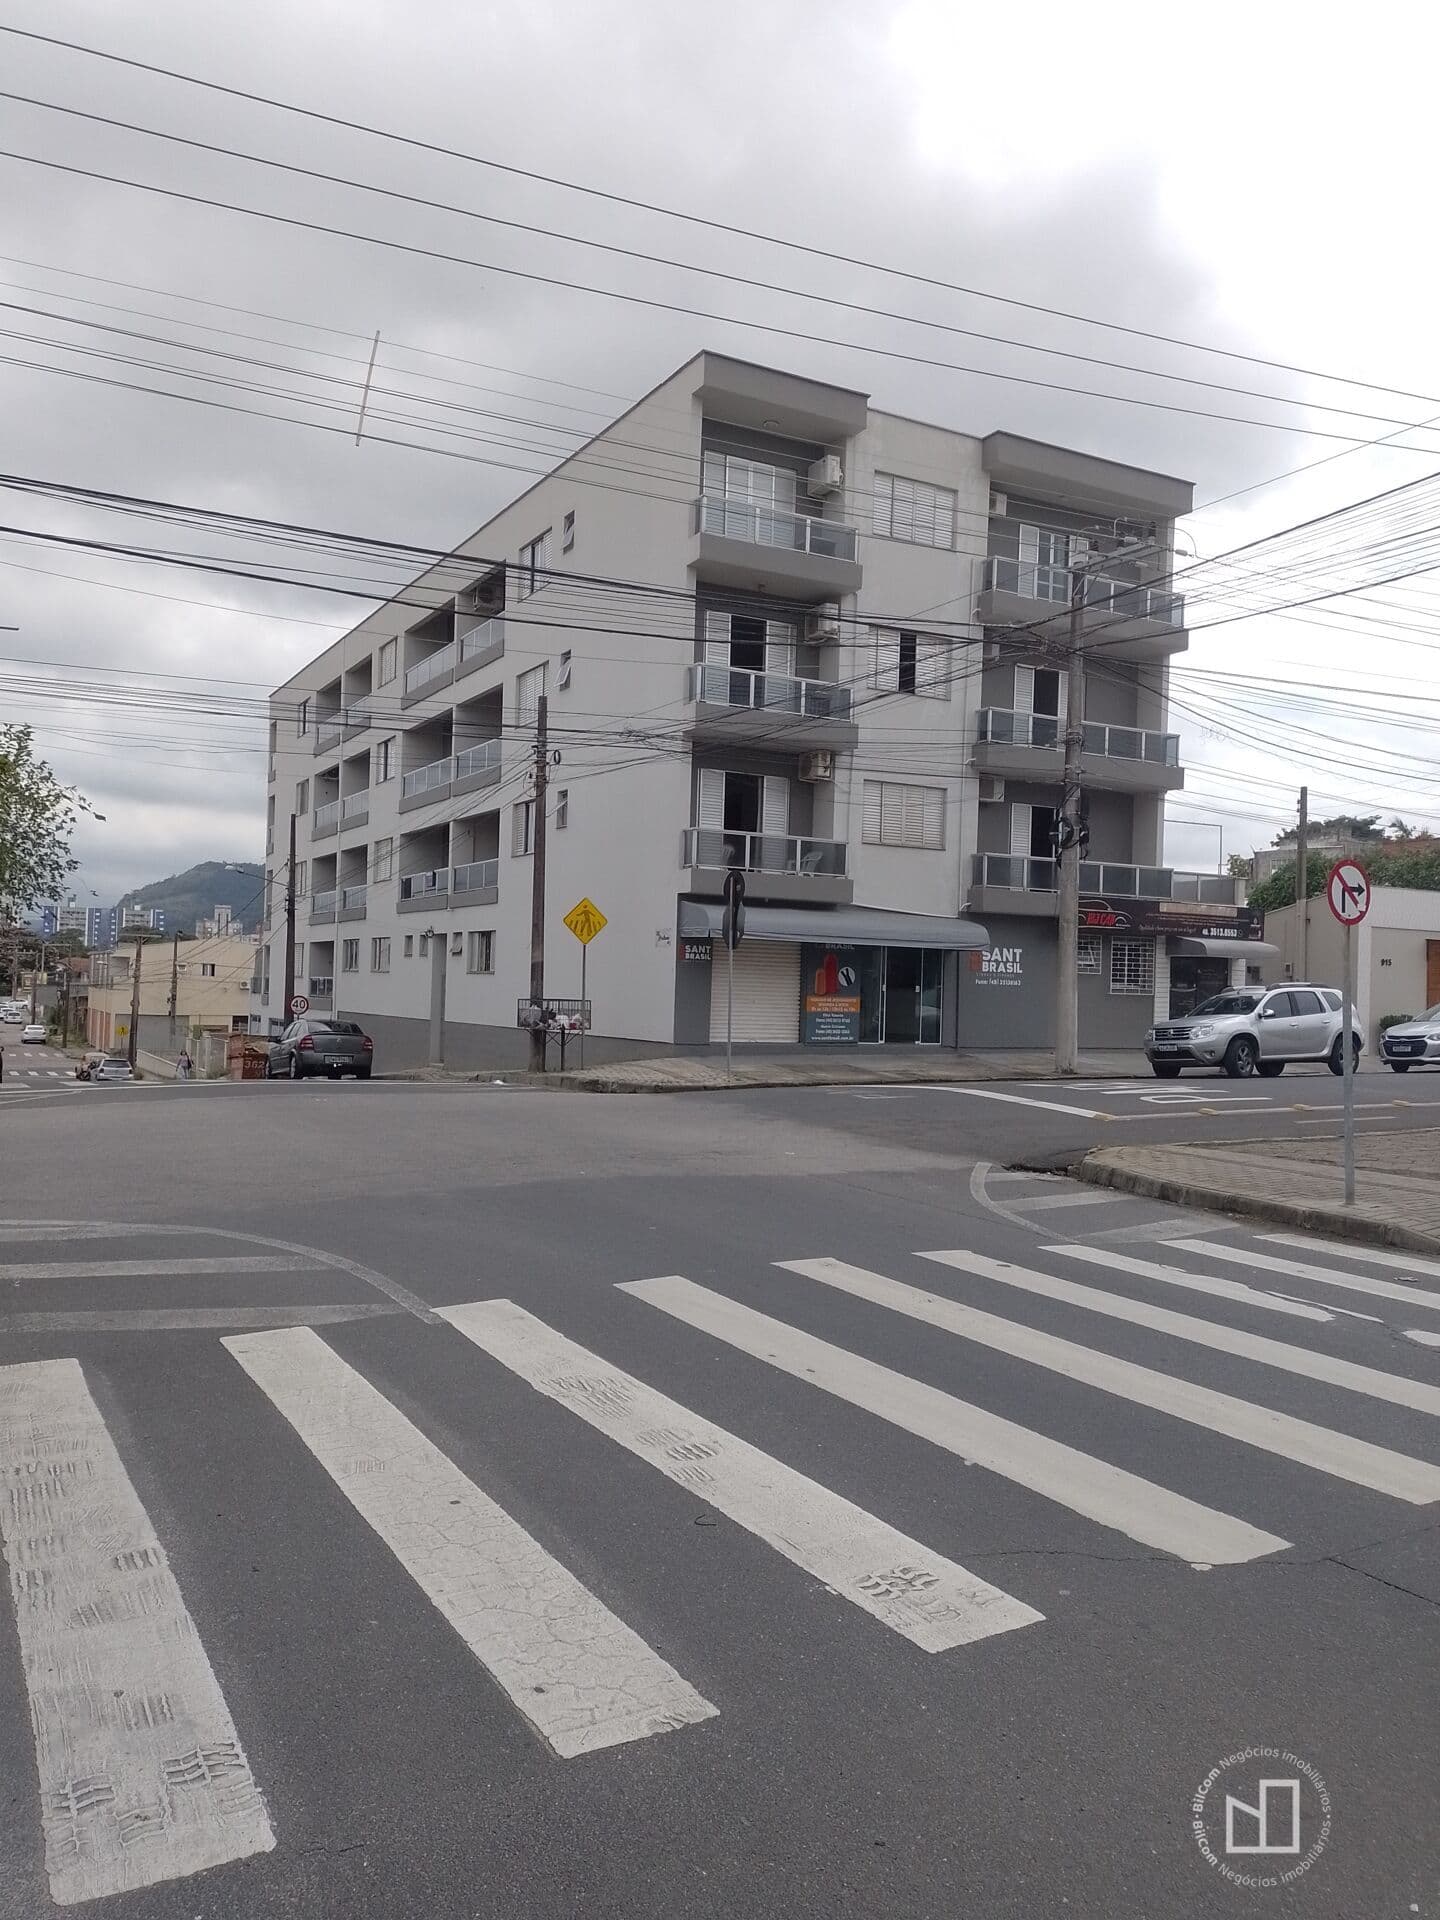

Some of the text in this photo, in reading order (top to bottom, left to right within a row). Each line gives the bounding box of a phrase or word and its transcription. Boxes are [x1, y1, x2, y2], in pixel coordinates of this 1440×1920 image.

[685, 944, 711, 953] SANT
[982, 947, 1022, 962] SANT
[982, 961, 1023, 974] BRASIL
[291, 999, 306, 1009] 40
